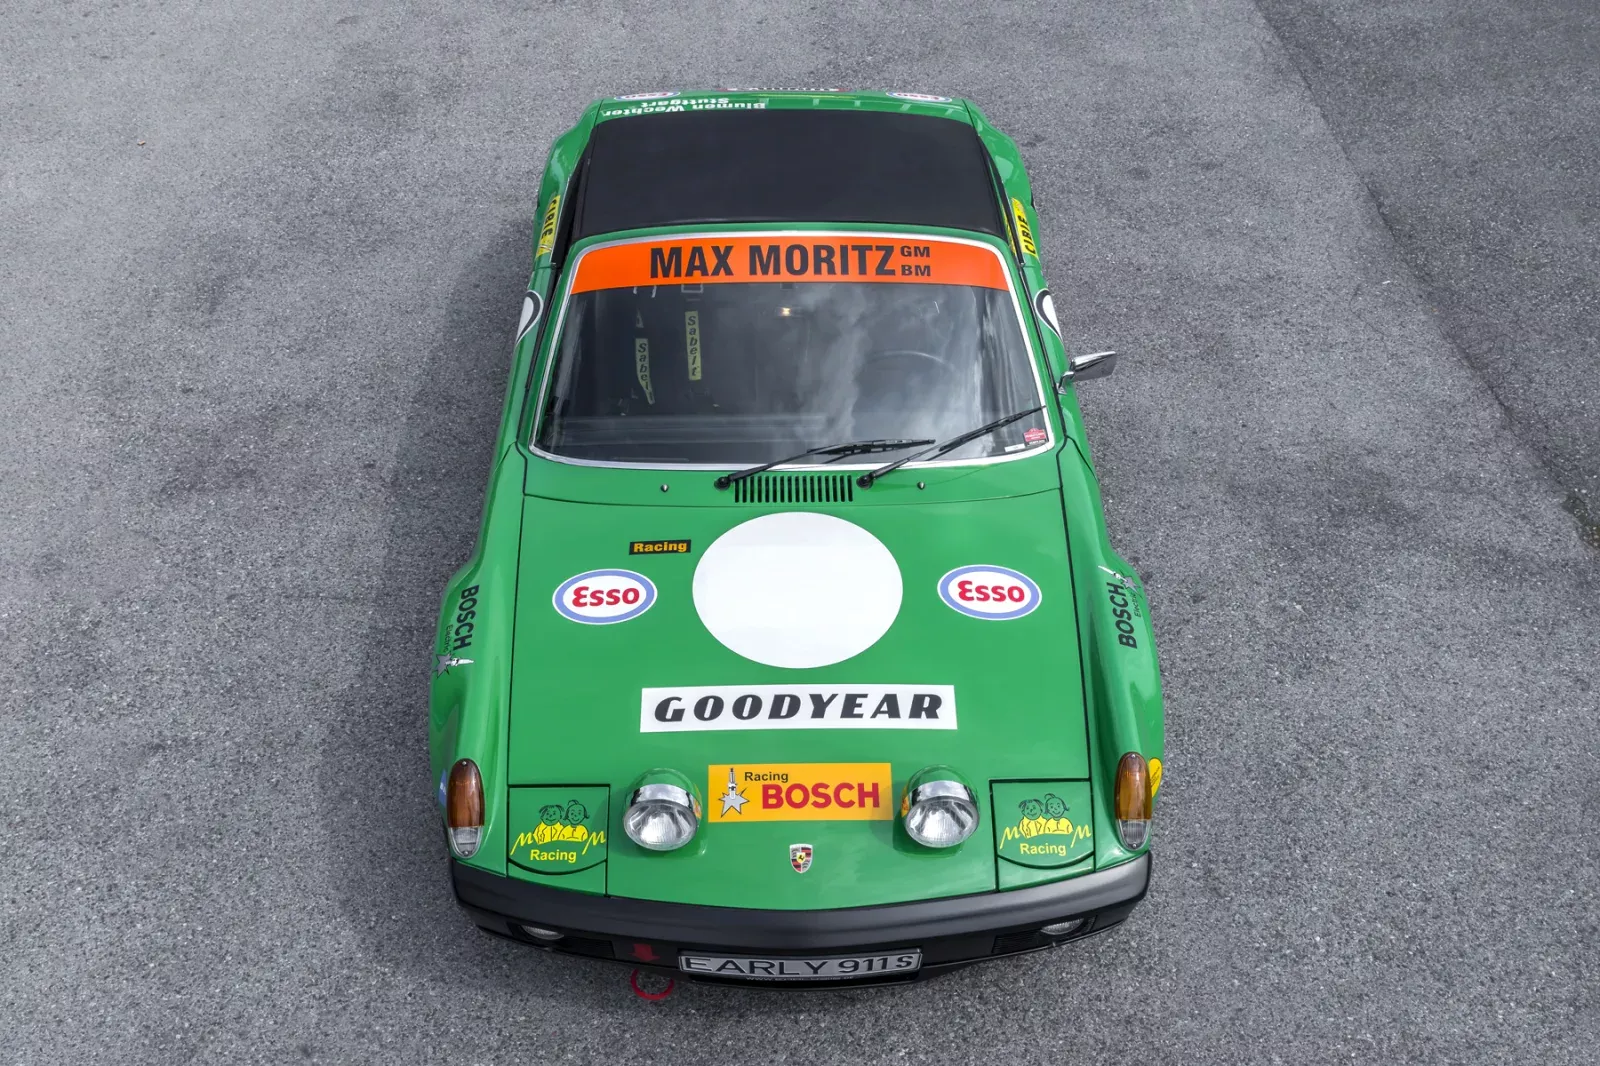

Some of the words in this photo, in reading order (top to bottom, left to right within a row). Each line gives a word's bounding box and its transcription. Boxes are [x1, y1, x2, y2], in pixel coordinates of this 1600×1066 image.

[641, 98, 729, 108] Stuttgart
[692, 102, 766, 110] Blumen
[650, 245, 734, 279] MAX
[749, 243, 896, 276] MORITZ
[900, 245, 931, 258] GM
[900, 264, 931, 277] BM
[687, 315, 699, 377] Sabelt
[633, 541, 688, 553] Racing
[572, 585, 640, 607] Esso
[957, 579, 1025, 603] Esso
[453, 584, 480, 651] BOSCH
[1106, 582, 1138, 649] BOSCH
[654, 693, 943, 723] GOODYEAR
[744, 771, 789, 783] Racing
[762, 782, 880, 809] BOSCH
[530, 849, 577, 864] Racing
[1019, 843, 1066, 856] Racing
[684, 957, 828, 976] EARLY
[838, 957, 888, 974] 911
[895, 955, 914, 969] S
